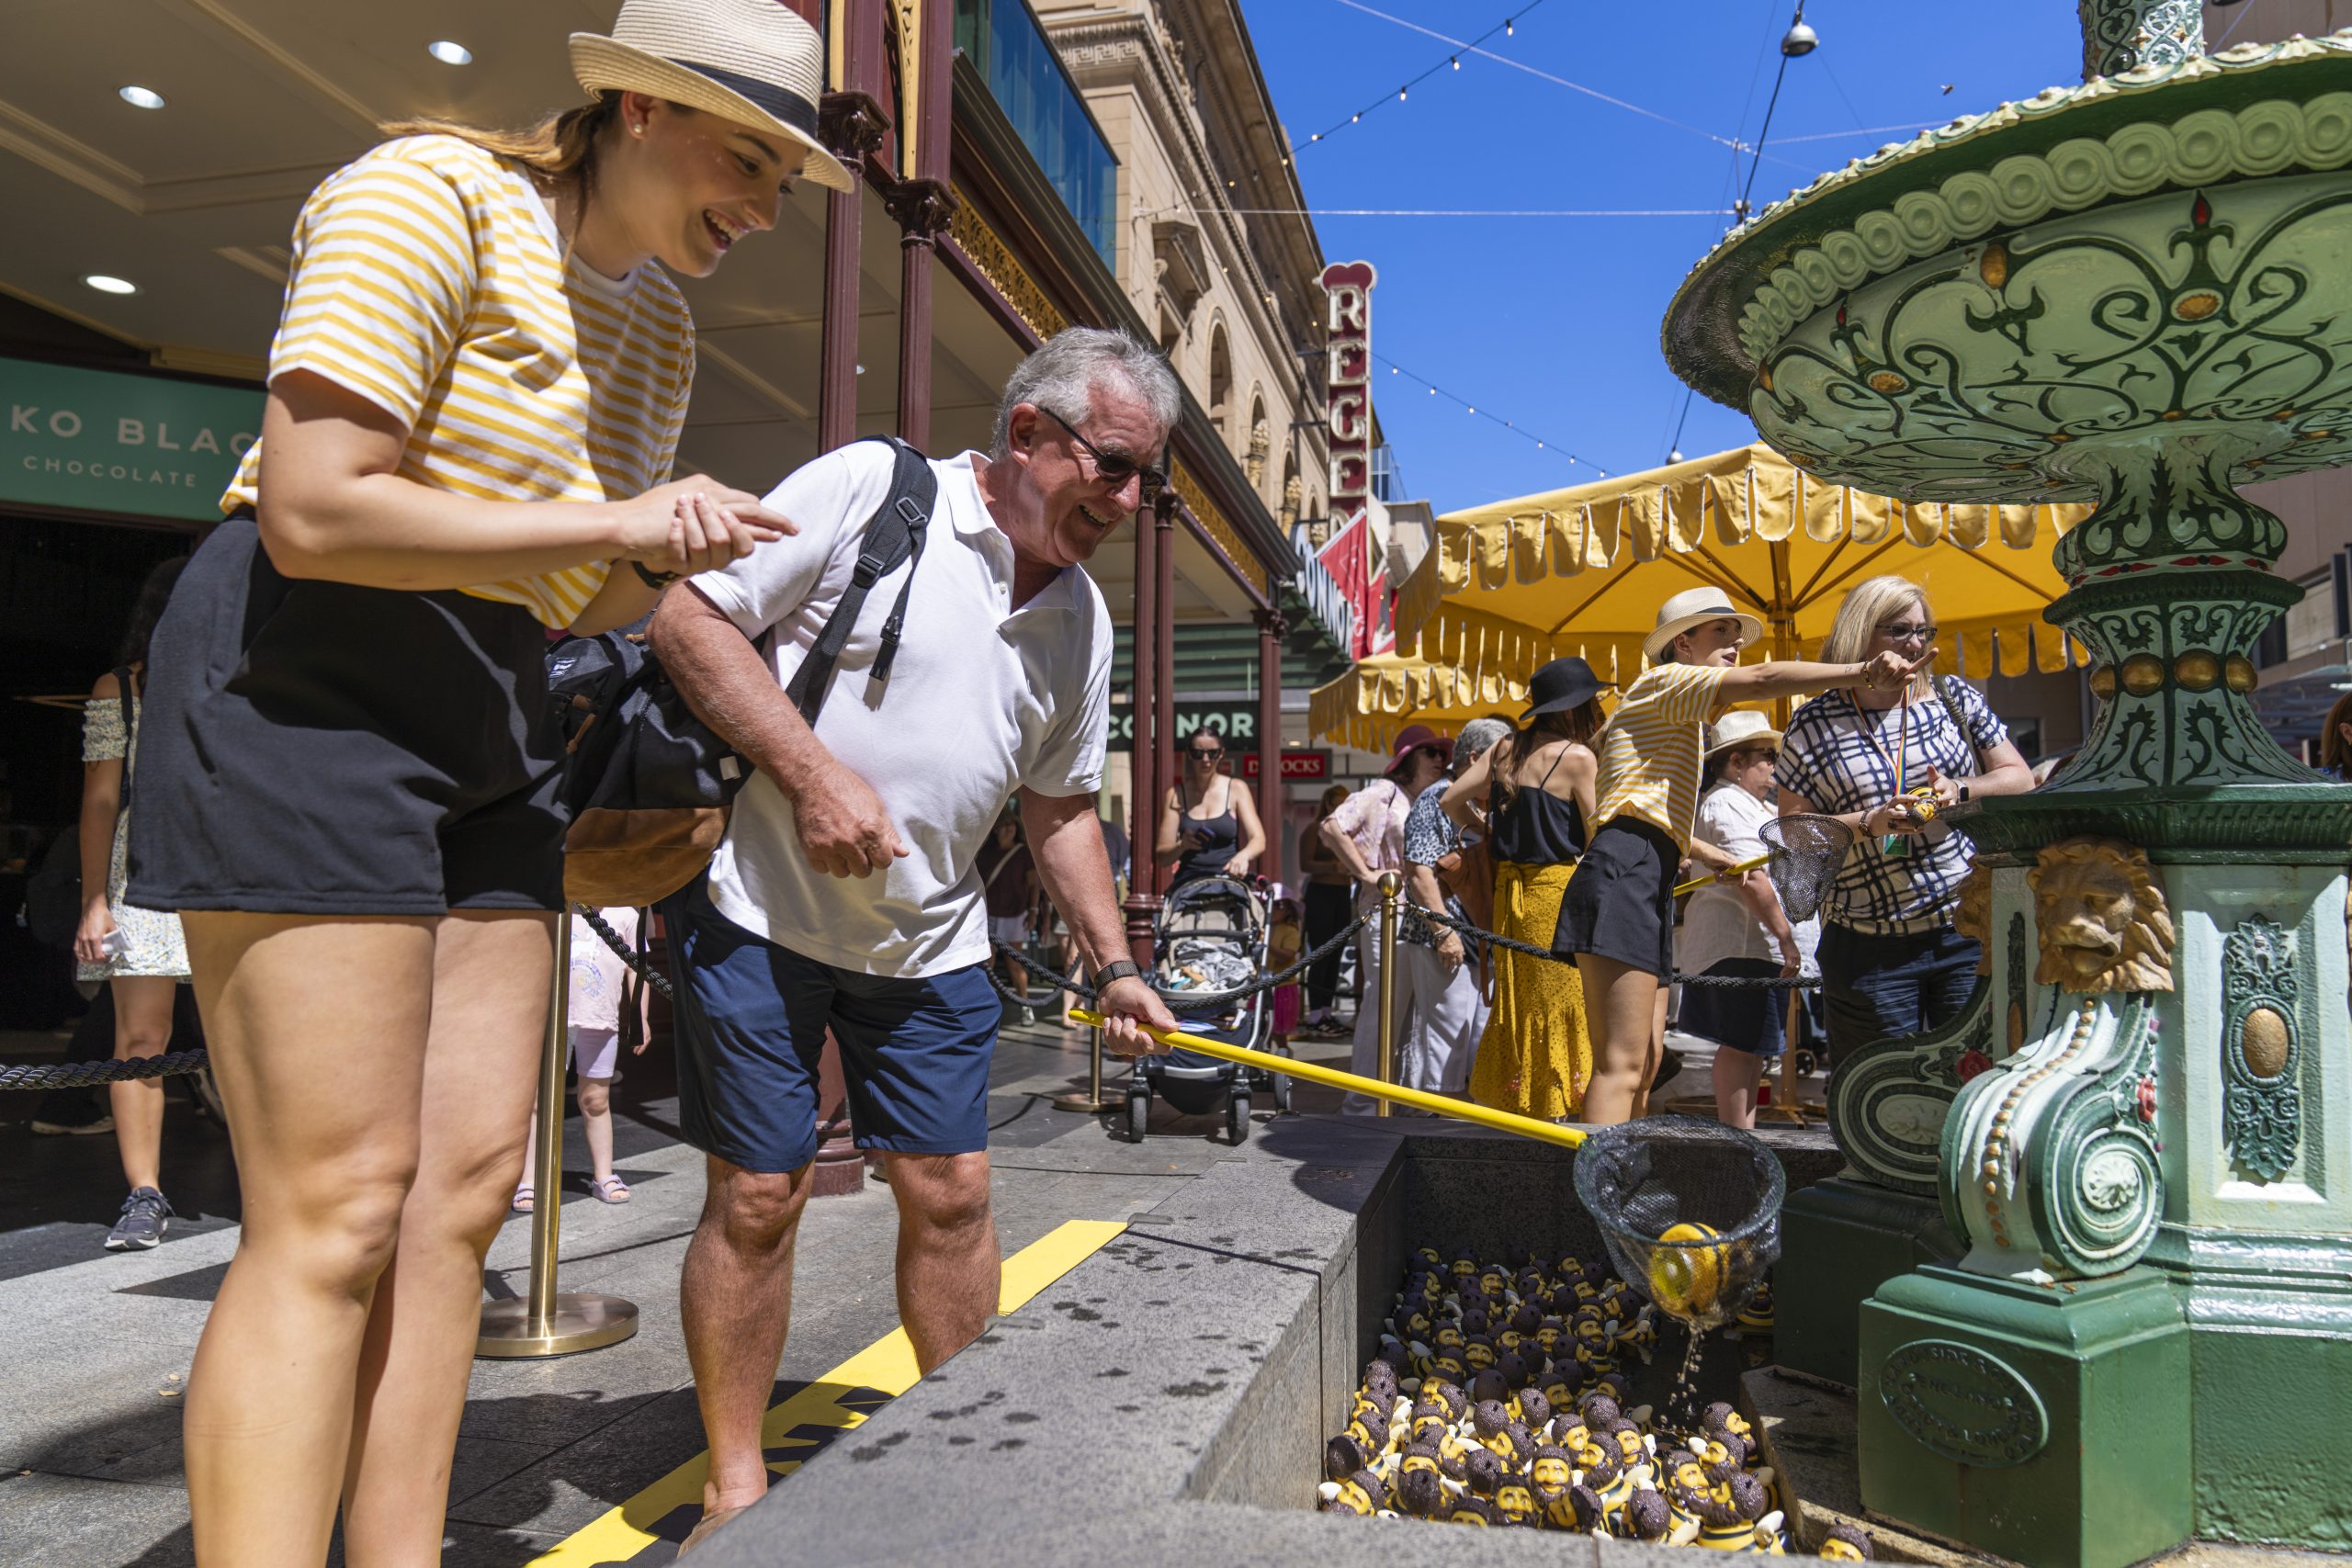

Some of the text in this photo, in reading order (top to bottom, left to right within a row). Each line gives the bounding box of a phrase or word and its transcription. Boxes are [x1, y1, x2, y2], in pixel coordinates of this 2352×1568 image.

[118, 417, 258, 458] BLAC
[23, 456, 197, 488] CHOCOLATE
[1249, 759, 1321, 773] DOCKS
